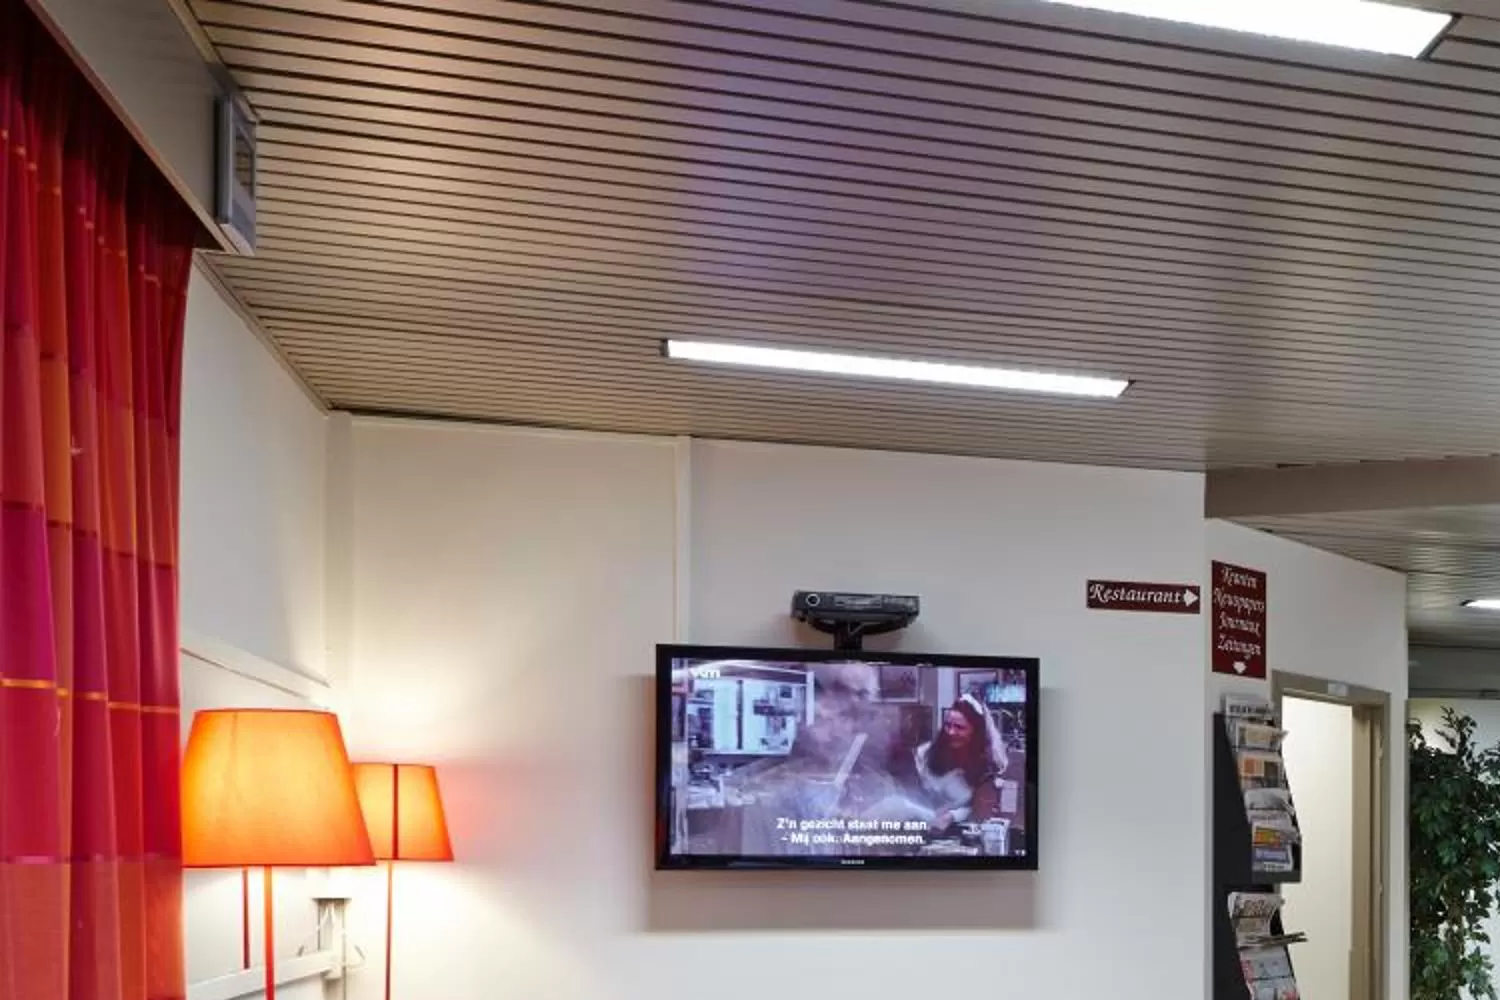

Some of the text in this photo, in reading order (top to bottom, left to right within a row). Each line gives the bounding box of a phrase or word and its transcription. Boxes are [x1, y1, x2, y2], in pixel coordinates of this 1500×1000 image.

[1089, 583, 1181, 603] Restaurant
[776, 818, 797, 829] Z'n
[800, 818, 845, 831] gezicht
[882, 821, 901, 830] me
